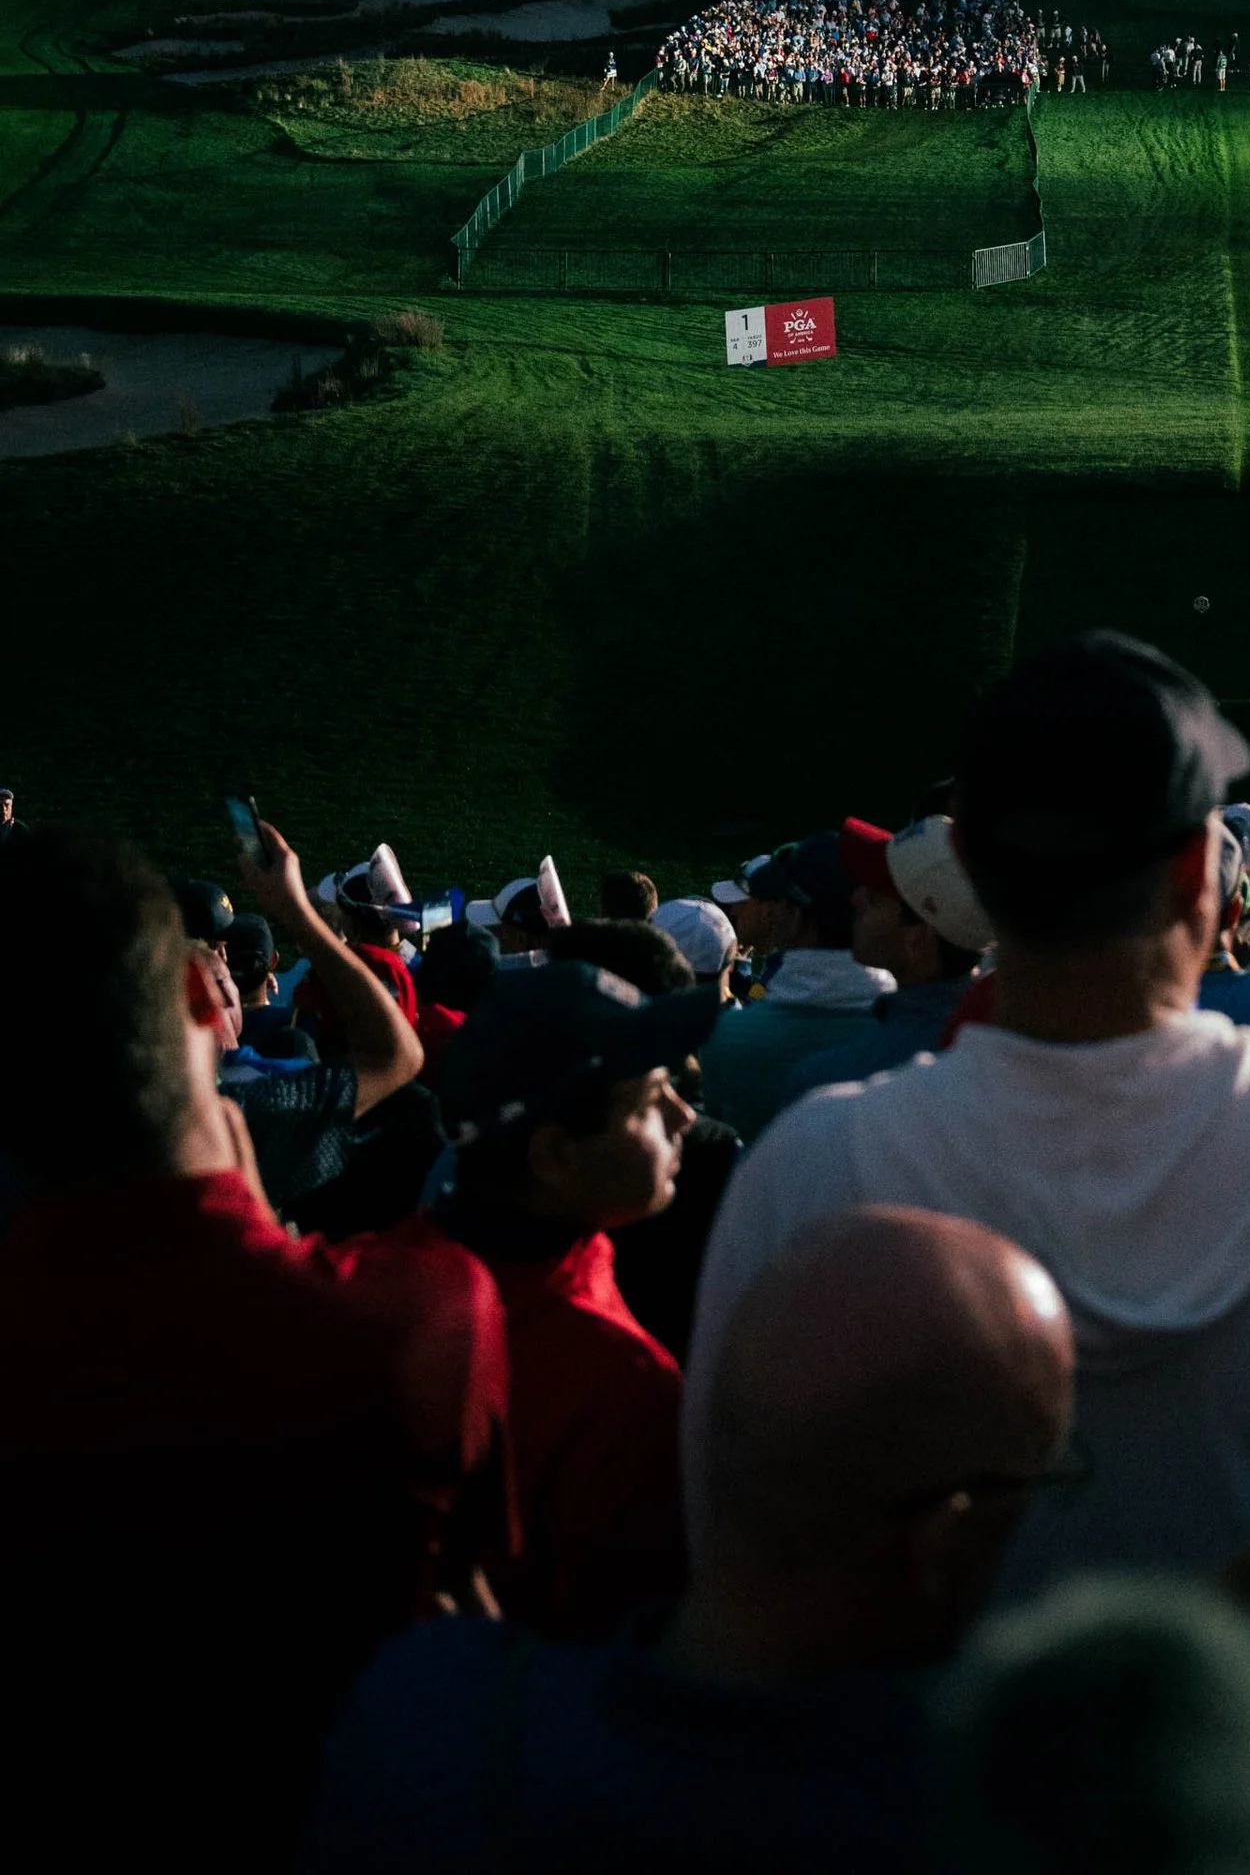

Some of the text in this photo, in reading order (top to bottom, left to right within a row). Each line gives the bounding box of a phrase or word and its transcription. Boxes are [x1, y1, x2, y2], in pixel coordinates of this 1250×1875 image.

[741, 314, 748, 330] 1
[783, 318, 816, 333] PGA
[748, 340, 762, 348] 397
[773, 350, 783, 358] We
[784, 349, 798, 357] Love
[799, 346, 811, 354] this
